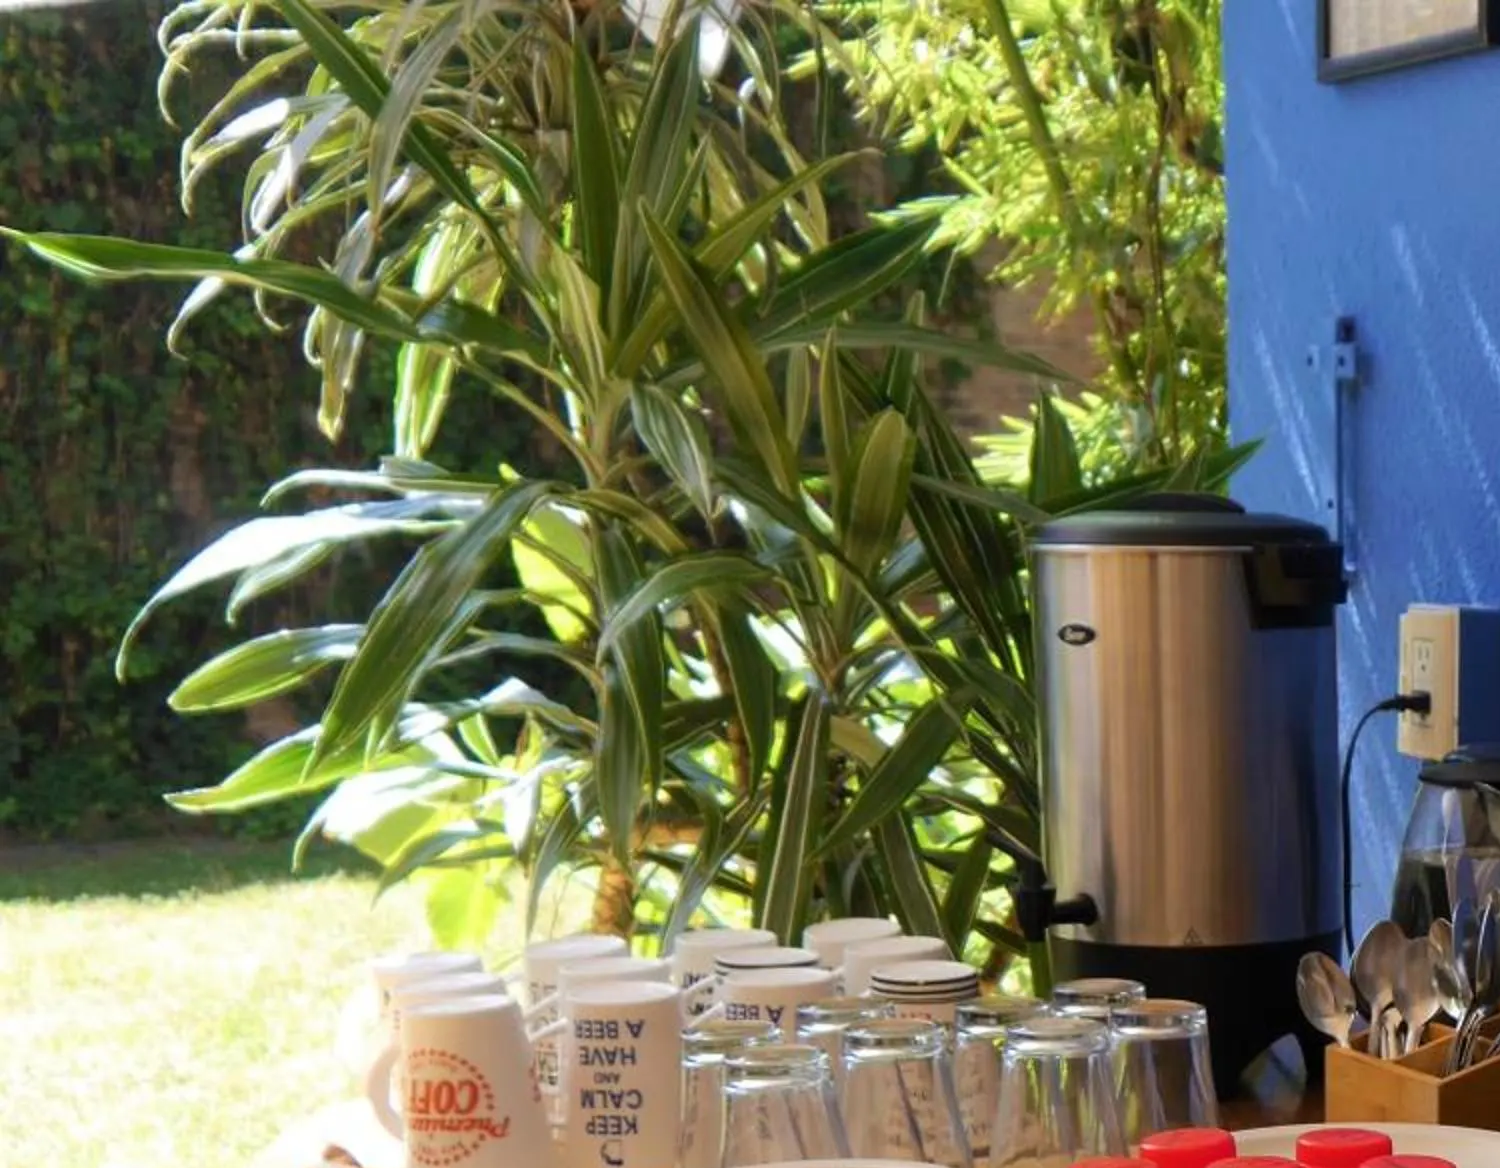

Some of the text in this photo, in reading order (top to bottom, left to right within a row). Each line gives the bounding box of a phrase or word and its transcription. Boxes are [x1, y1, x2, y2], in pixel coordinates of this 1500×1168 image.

[573, 1017, 647, 1041] A BEER
[578, 1045, 639, 1068] HAVE
[593, 1070, 622, 1086] AND
[579, 1088, 644, 1110] CALM
[584, 1113, 640, 1137] KEEP
